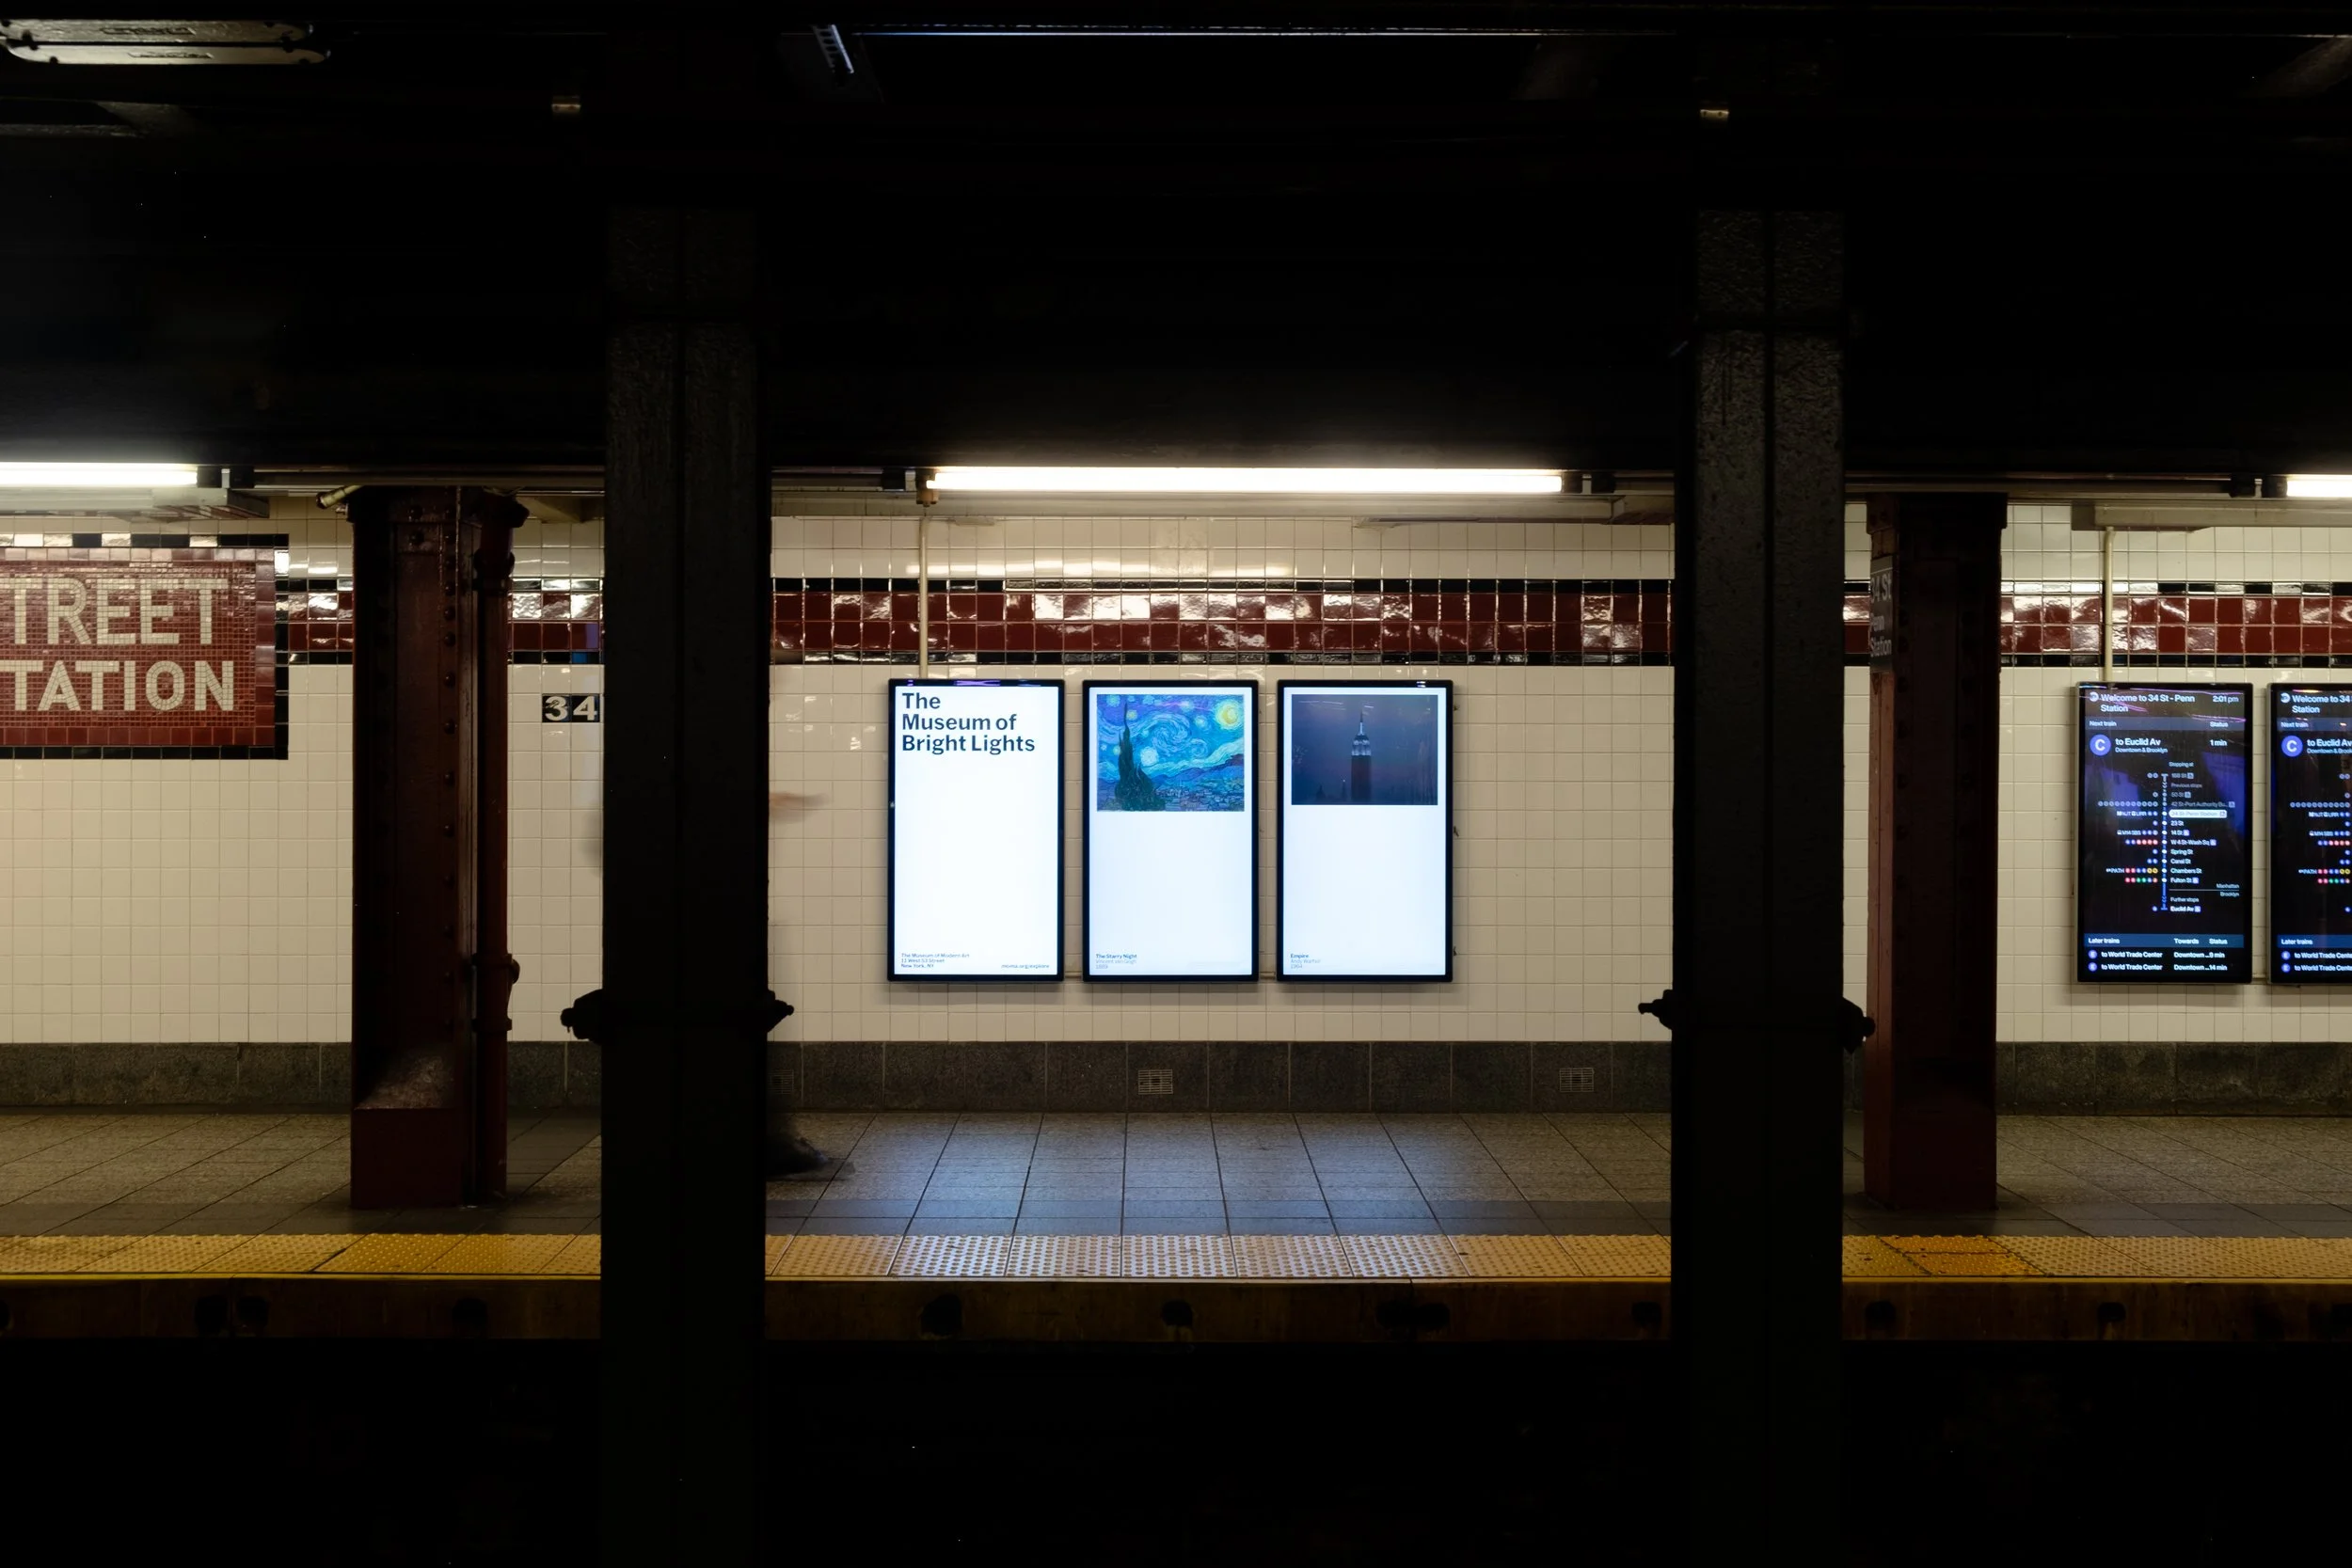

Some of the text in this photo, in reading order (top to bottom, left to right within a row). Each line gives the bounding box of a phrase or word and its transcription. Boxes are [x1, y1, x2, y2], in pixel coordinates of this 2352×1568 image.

[1882, 572, 1892, 601] St
[0, 578, 229, 645] TREET
[0, 660, 234, 711] TATION
[902, 692, 941, 709] The
[2101, 693, 2137, 703] Welcome
[2139, 693, 2147, 703] to
[2148, 693, 2159, 703] 34
[2160, 693, 2169, 703] St
[2174, 693, 2195, 703] Penn
[2212, 694, 2227, 703] 2:01
[2292, 694, 2329, 703] Welcome
[2330, 694, 2338, 703] to
[2339, 694, 2351, 703] 34
[545, 696, 598, 721] 34
[902, 713, 1017, 731] Museum of
[902, 735, 1035, 755] Bright Lights
[2094, 738, 2106, 752] C
[2286, 739, 2297, 752] C
